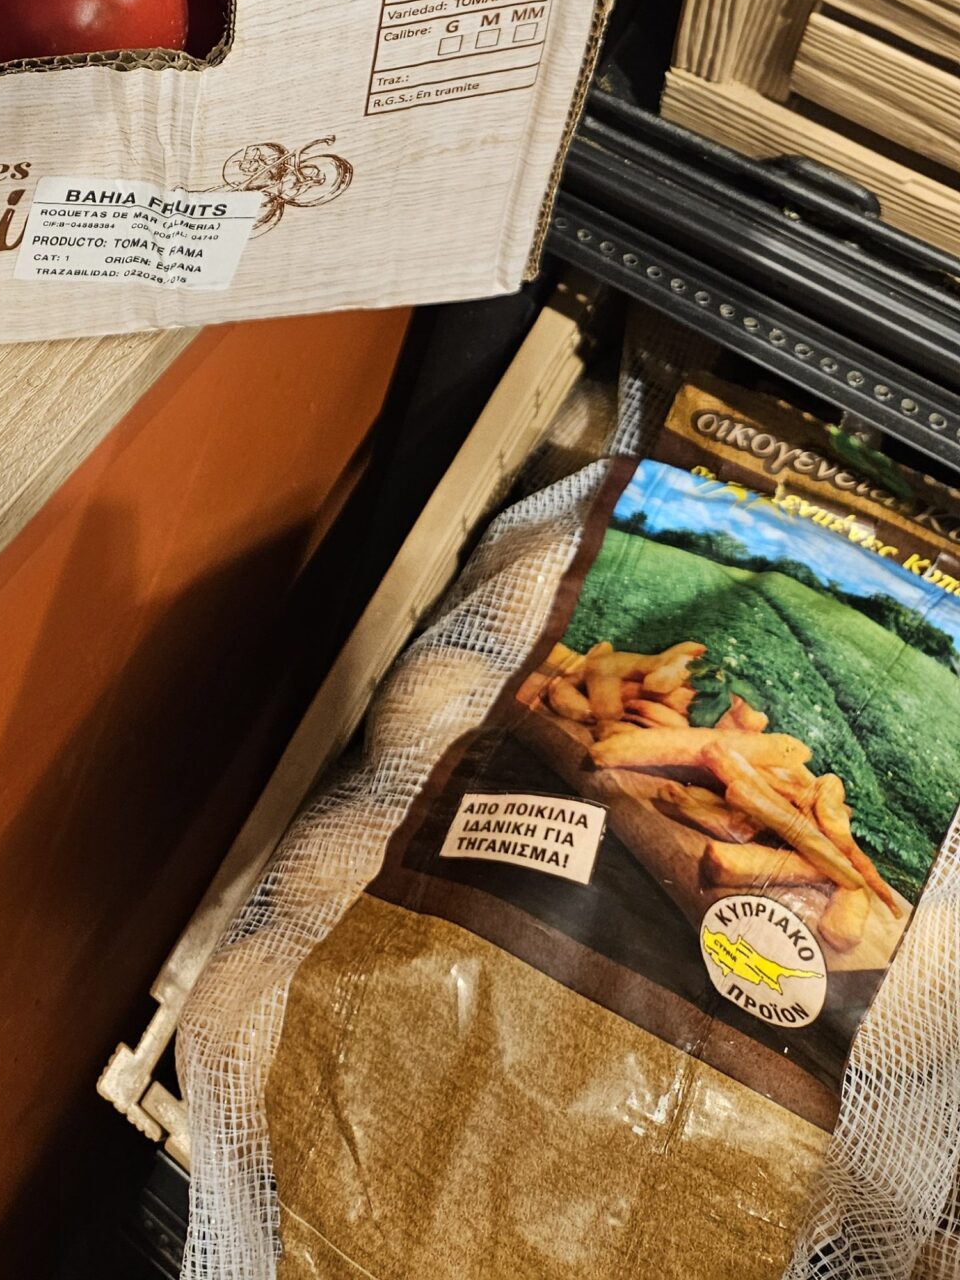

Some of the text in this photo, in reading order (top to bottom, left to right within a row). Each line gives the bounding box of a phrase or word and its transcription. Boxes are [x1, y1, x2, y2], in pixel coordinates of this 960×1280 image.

[384, 5, 545, 42] Calibre: G M MM
[387, 1, 448, 20] Variedad:
[377, 74, 410, 87] Traz.:
[373, 82, 480, 108] R.G.S.: En tramite
[40, 209, 107, 219] ROQUETAS
[113, 211, 129, 219] DE
[133, 211, 158, 224] MAR
[65, 189, 228, 217] BAHIA FRUITS
[32, 235, 107, 248] PRODUCTO:
[114, 238, 165, 256] TOMATE
[33, 254, 60, 262] CAT:
[104, 256, 152, 266] ORIGEN:
[36, 268, 119, 277] TRAZABILIDAD:
[463, 802, 589, 830] ΑΠΟ ΠΟΙΚΙΛΙΑ
[462, 819, 575, 848] ΙΔΑΝΙΚΗ ΓΙΑ
[456, 836, 570, 869] ΤΗΓΑΝΙΣΜΑ!
[714, 902, 815, 961] ΚΥΠΡΙΑΚΟ
[727, 983, 810, 1023] ΠΡΟΪΟΝ
